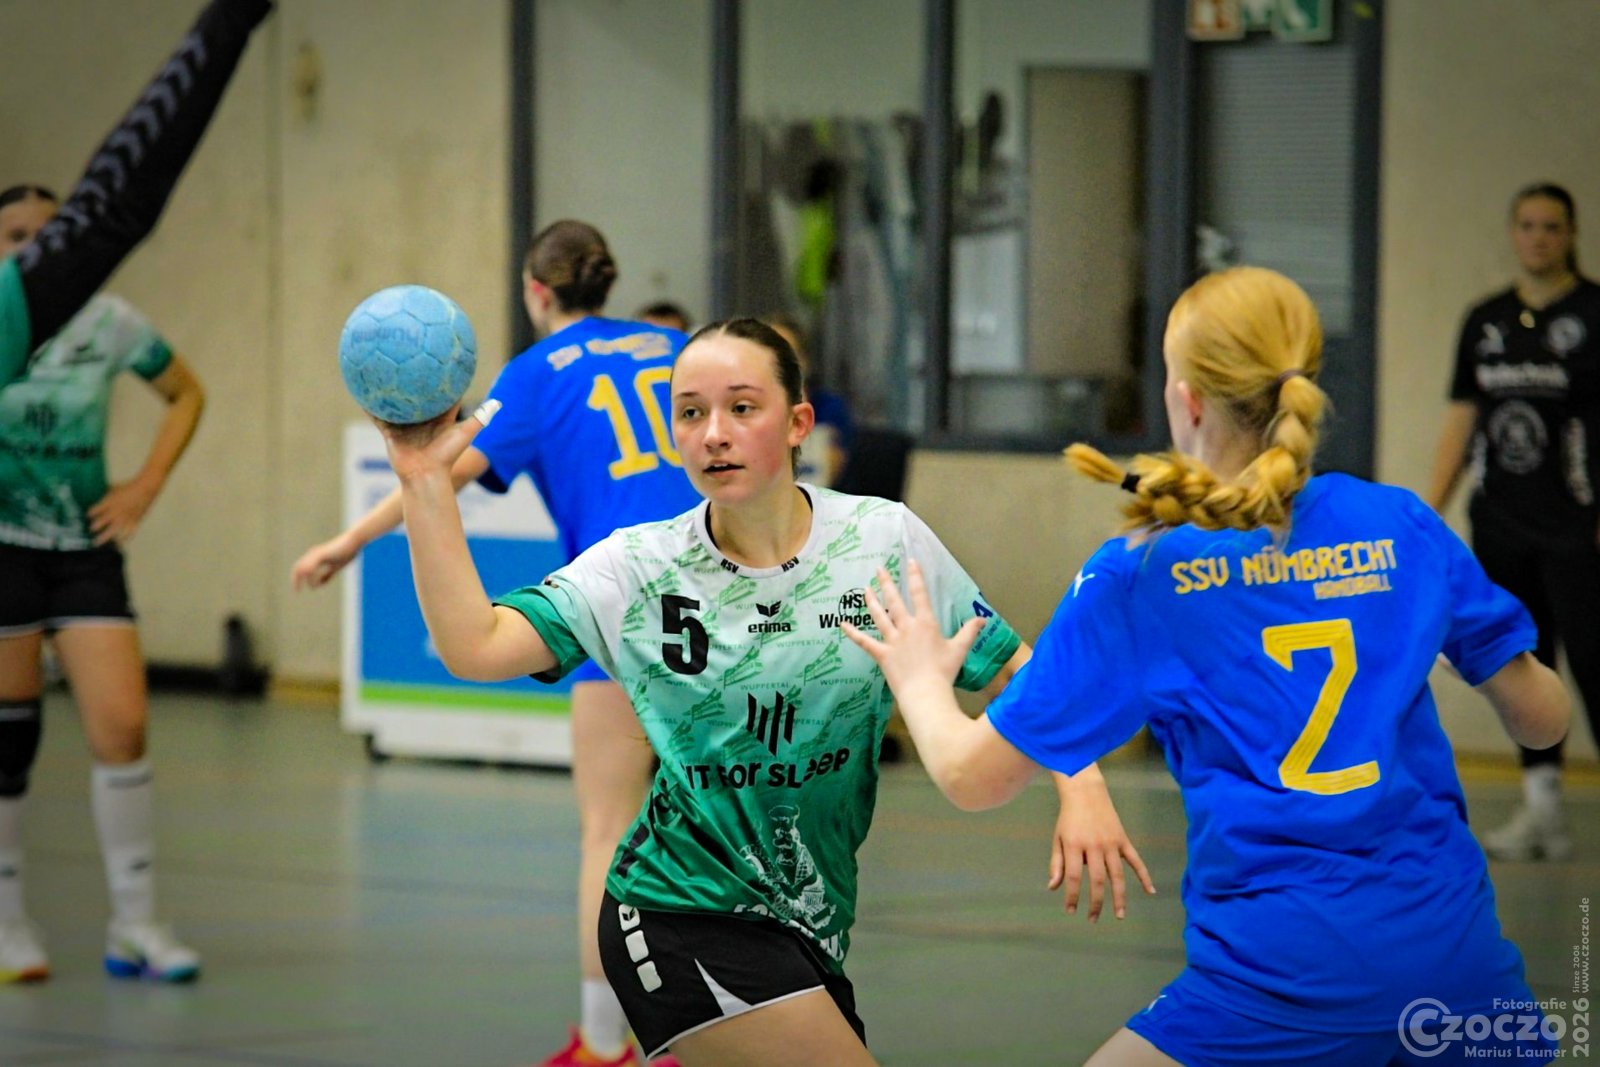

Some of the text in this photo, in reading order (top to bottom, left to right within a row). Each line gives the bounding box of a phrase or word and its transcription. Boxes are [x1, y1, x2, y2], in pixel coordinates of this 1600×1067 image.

[720, 558, 740, 574] HSV
[781, 556, 800, 572] HSV
[1171, 539, 1397, 594] SSV NÜMBRECHT
[842, 593, 867, 609] HS
[661, 594, 709, 675] 5
[748, 620, 792, 634] erima
[1262, 618, 1381, 795] 2
[682, 763, 710, 790] IT
